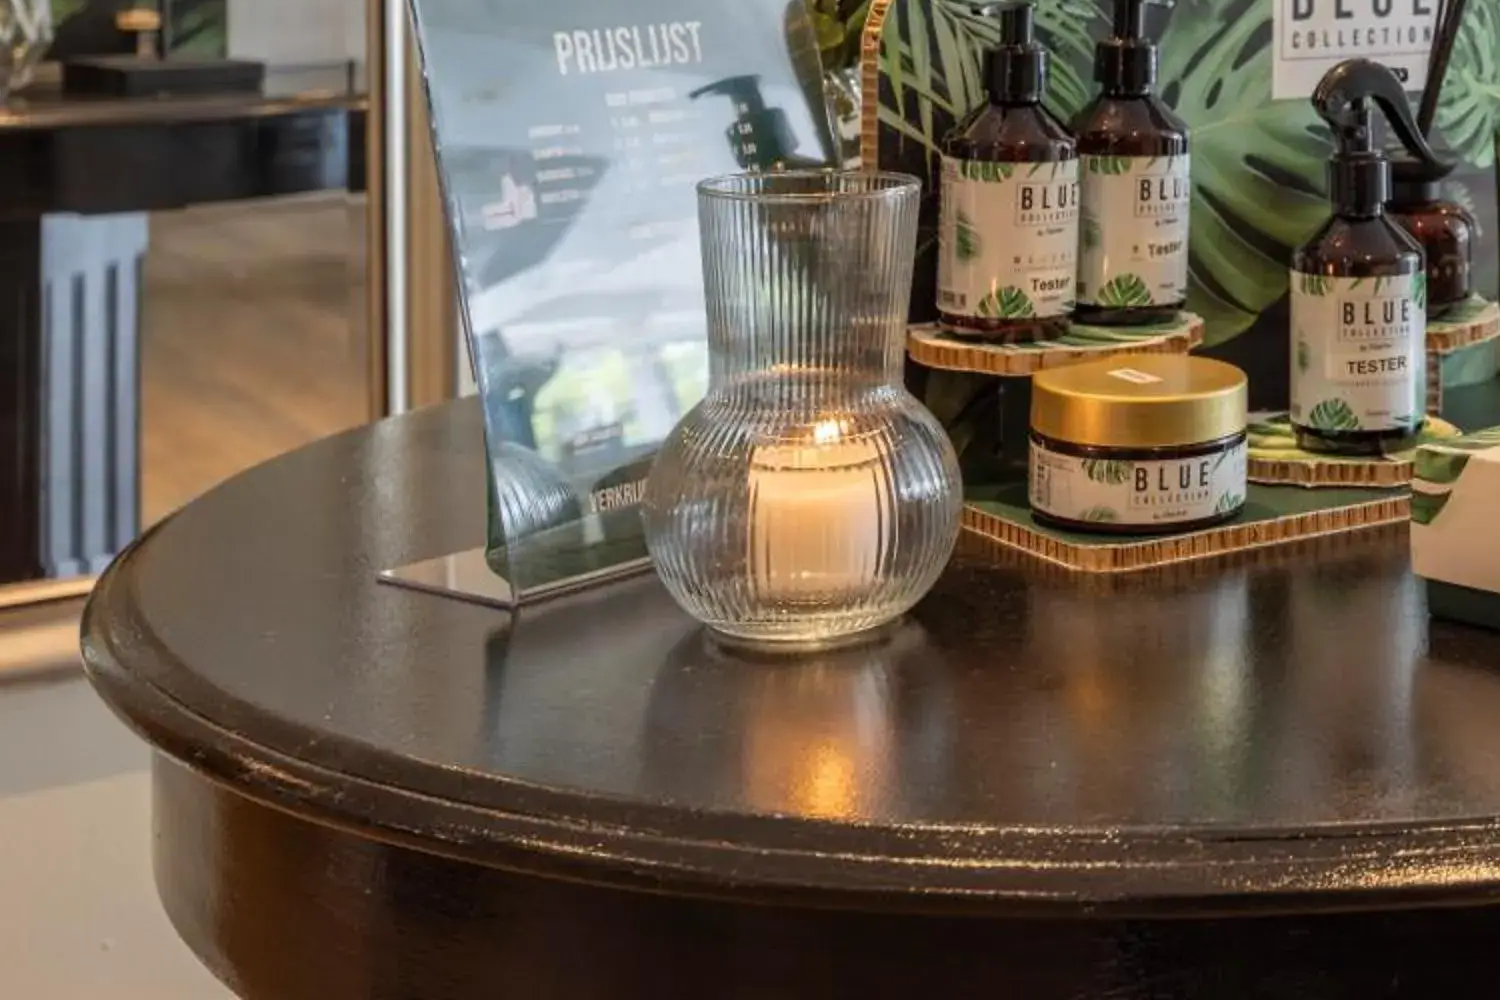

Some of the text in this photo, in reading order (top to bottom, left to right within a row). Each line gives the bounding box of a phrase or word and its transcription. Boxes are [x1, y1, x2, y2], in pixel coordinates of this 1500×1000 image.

[553, 20, 702, 76] PRIJSLIJST
[1292, 27, 1433, 49] COLLECTION
[1030, 276, 1071, 293] Tester
[1342, 299, 1410, 326] BLUE
[1347, 355, 1408, 376] TESTER
[1134, 460, 1210, 494] BLUE
